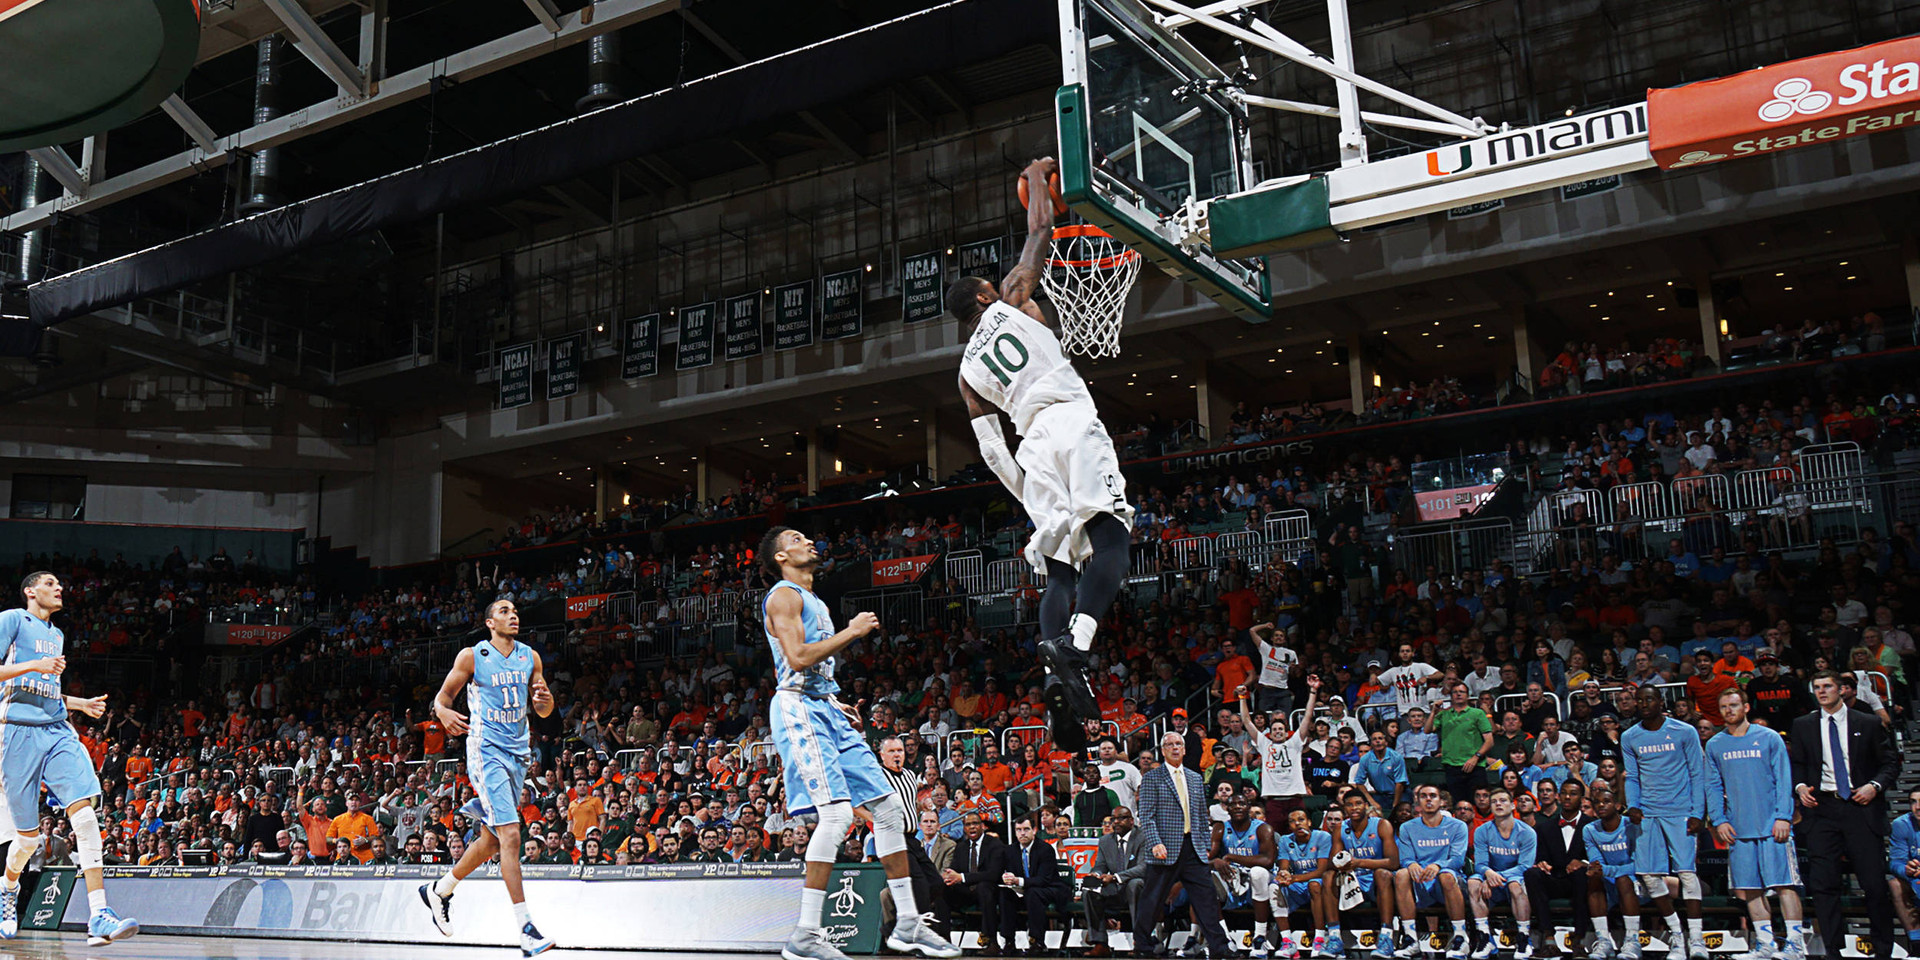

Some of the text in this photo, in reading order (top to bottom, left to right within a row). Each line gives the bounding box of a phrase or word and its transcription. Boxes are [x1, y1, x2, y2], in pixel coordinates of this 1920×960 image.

[1837, 59, 1920, 107] Sta
[1732, 126, 1840, 157] State
[961, 244, 999, 269] NCAA
[905, 256, 939, 280] NCAA
[826, 275, 859, 299] NCAA
[783, 287, 805, 309] NIT
[734, 298, 754, 319] NIT
[687, 309, 706, 329] NIT
[631, 319, 650, 340] NIT
[504, 350, 528, 371] NCAA
[556, 340, 574, 361] NIT
[980, 333, 1029, 388] 10
[1429, 497, 1451, 511] 101
[882, 565, 900, 577] 122
[574, 602, 588, 612] 121
[236, 630, 253, 639] 120
[267, 632, 282, 640] 121
[491, 671, 527, 687] NORTH
[501, 686, 520, 709] 11
[1755, 689, 1791, 700] MIAMI
[1638, 743, 1675, 754] CAROLINA
[1722, 750, 1761, 760] CAROLINA
[1312, 768, 1330, 777] UNC
[1417, 838, 1450, 847] CAROLINA
[420, 854, 433, 863] POSS
[1073, 852, 1085, 865] G
[300, 882, 412, 930] Bank
[1703, 936, 1722, 947] ups
